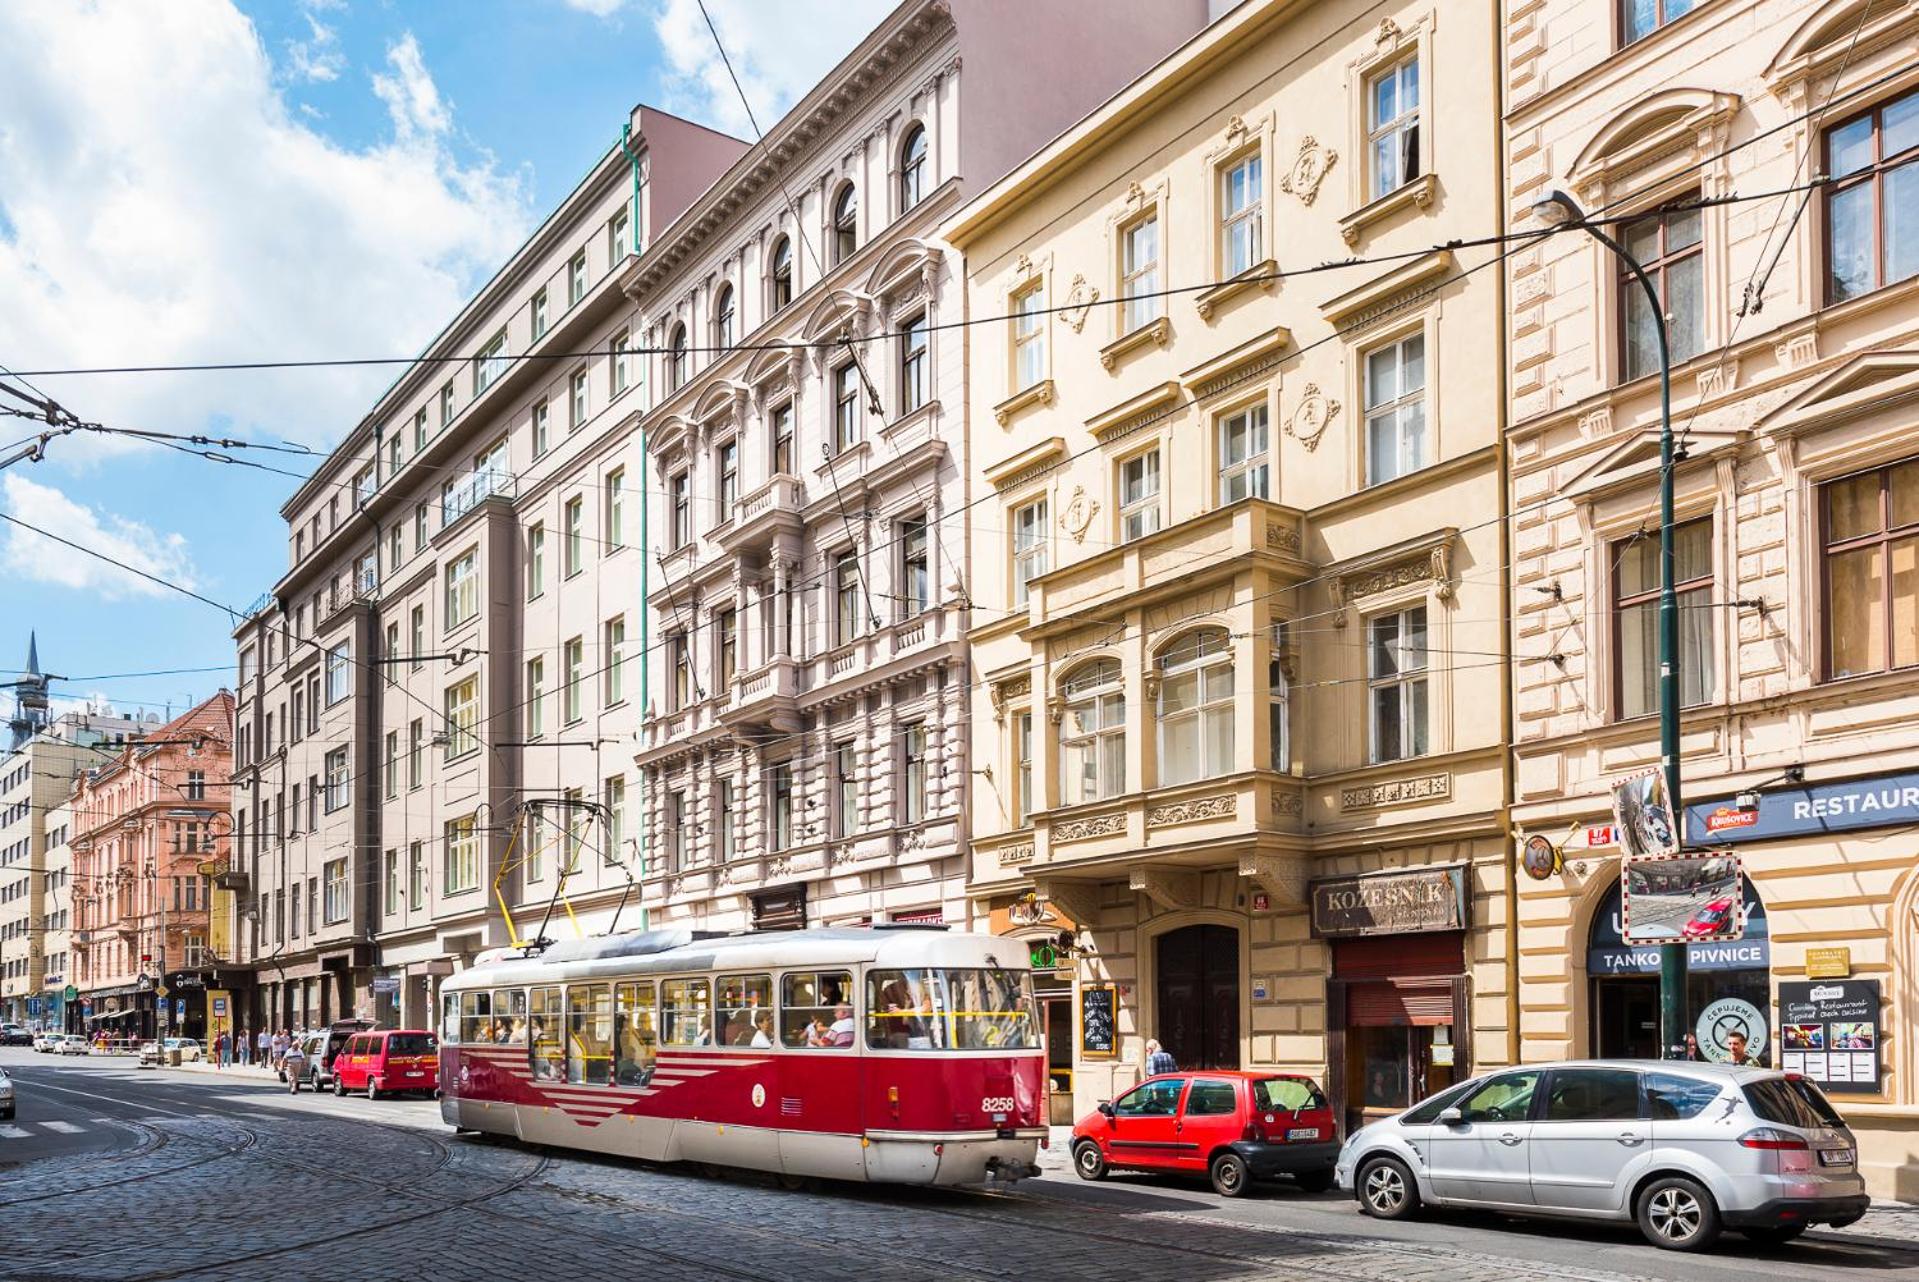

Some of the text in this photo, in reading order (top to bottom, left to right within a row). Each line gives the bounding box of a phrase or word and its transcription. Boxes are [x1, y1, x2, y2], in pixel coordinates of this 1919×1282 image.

[1604, 947, 1761, 968] TANKO PIVNICE
[981, 1097, 1014, 1112] 8258
